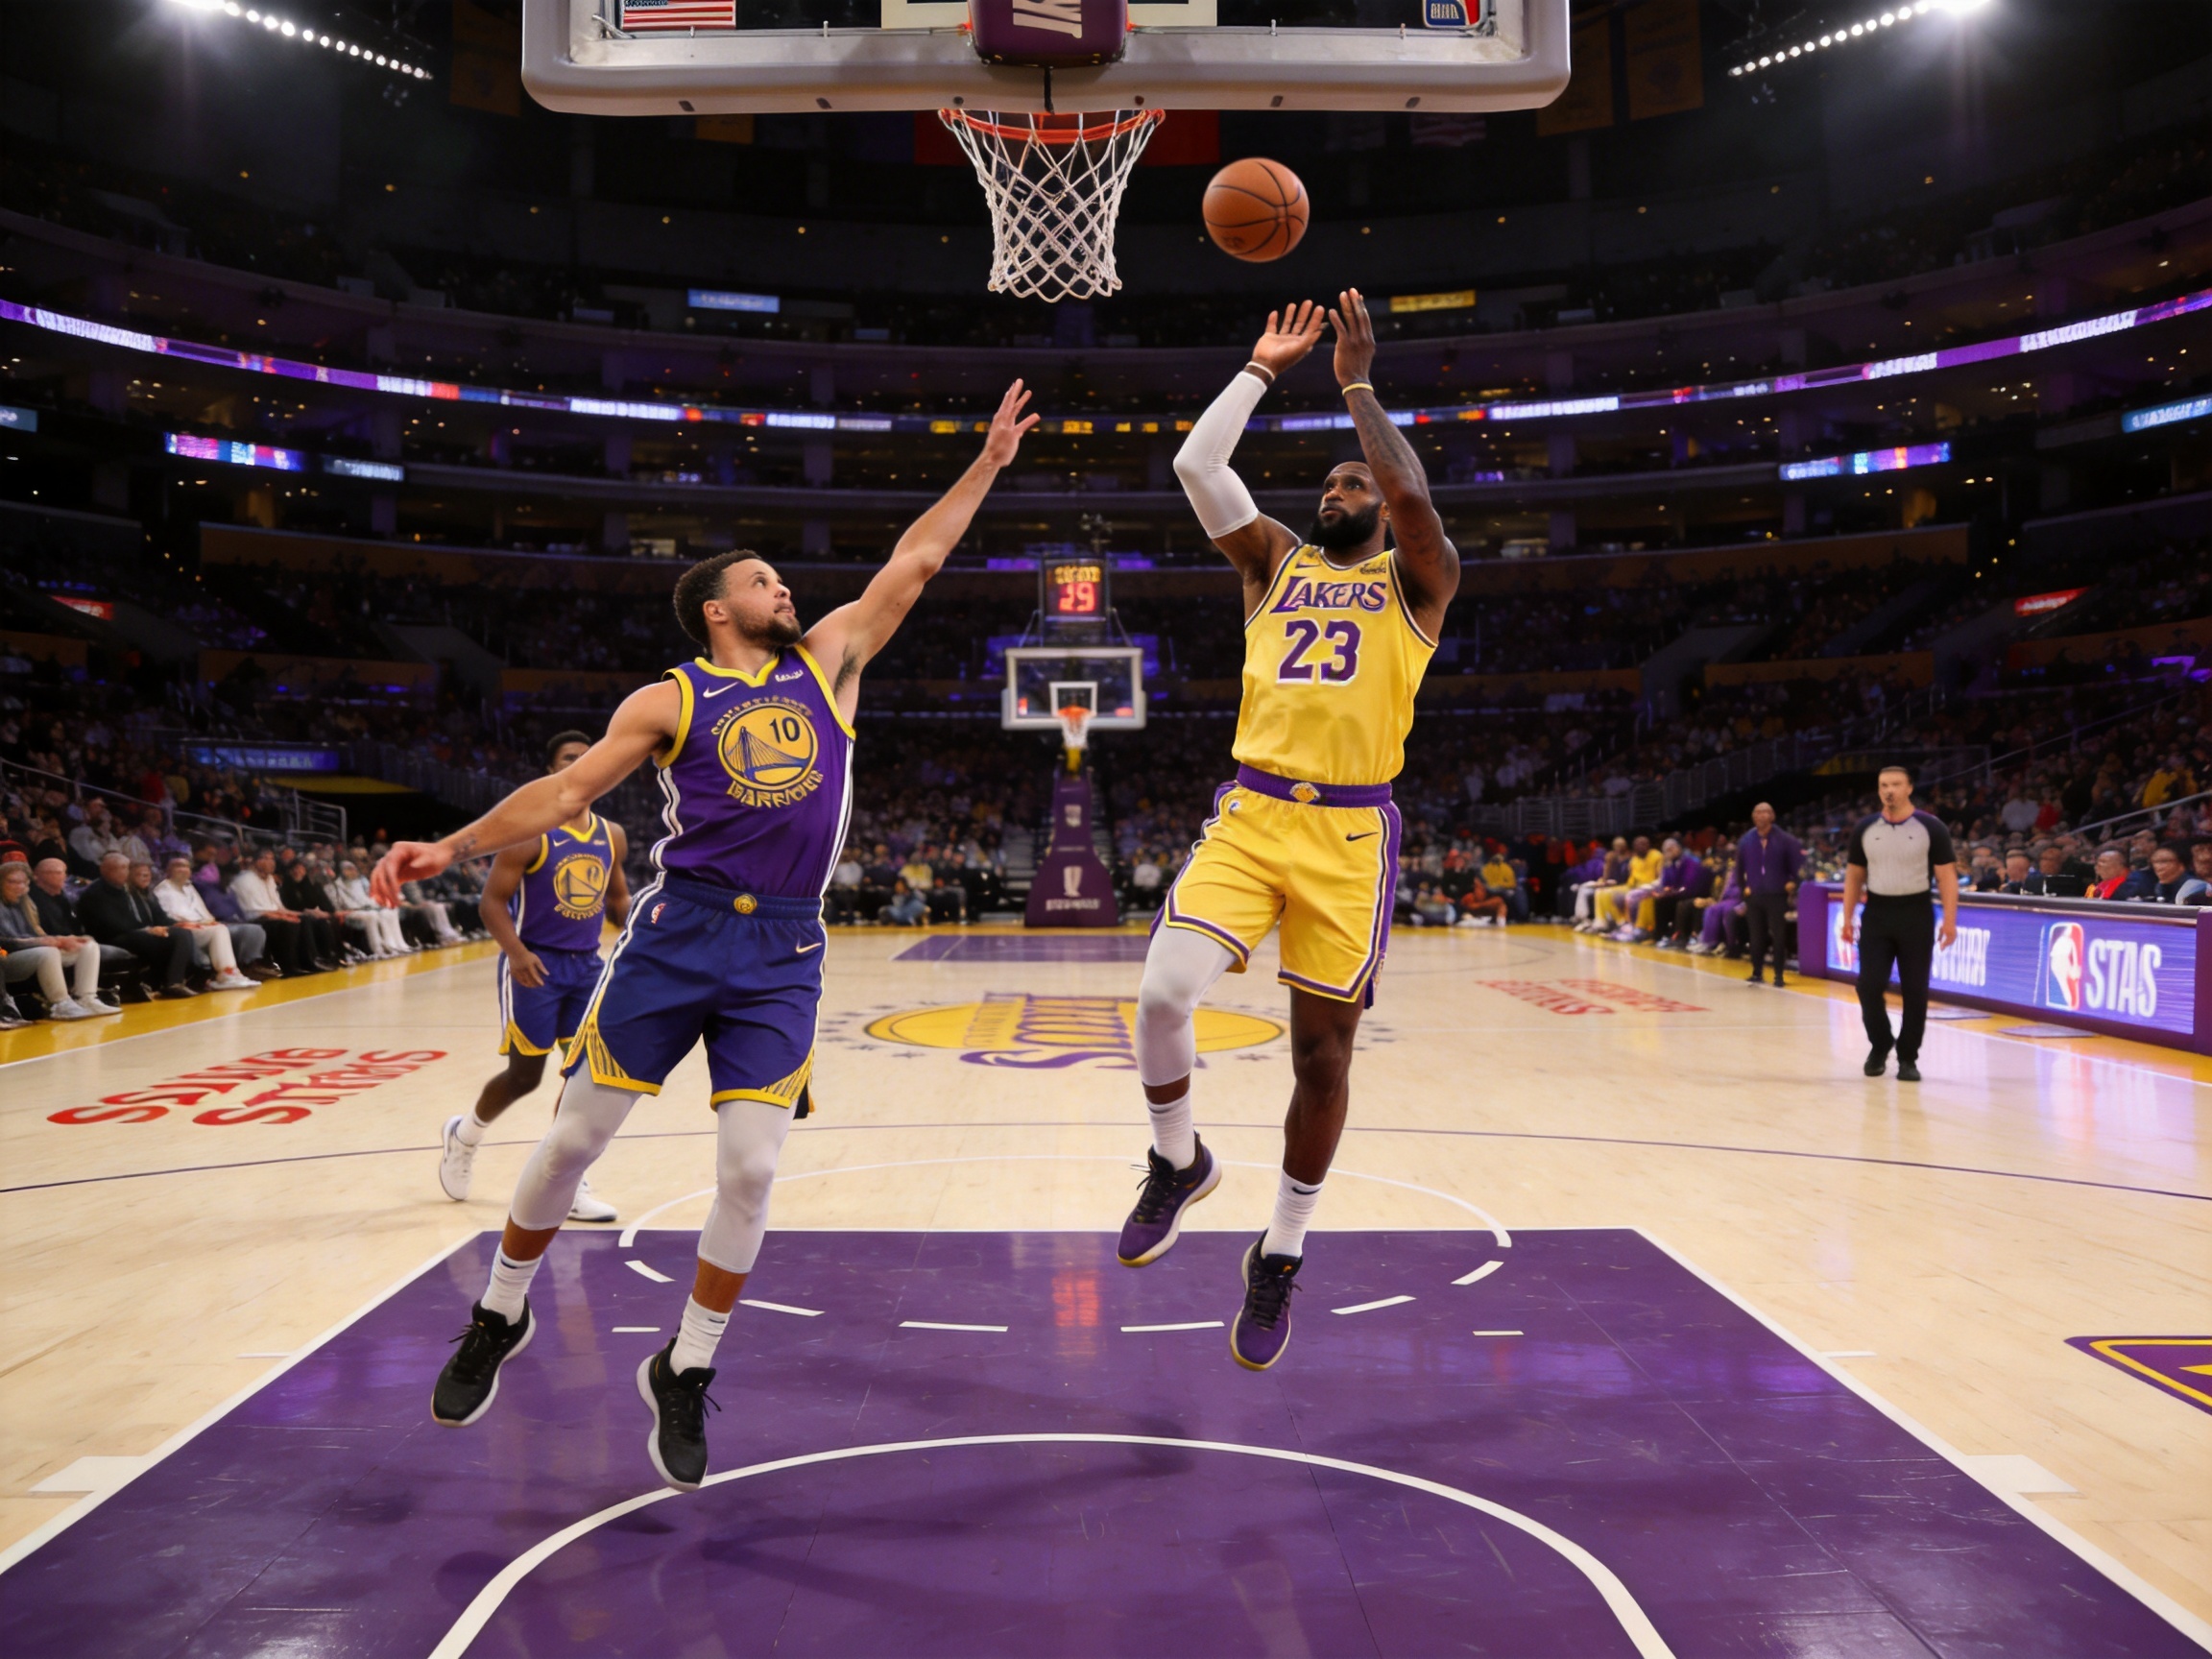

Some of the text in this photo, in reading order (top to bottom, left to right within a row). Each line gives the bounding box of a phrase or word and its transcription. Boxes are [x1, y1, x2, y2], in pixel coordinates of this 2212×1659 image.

[1269, 576, 1386, 613] LAKERS
[1277, 618, 1361, 685] 23
[769, 716, 801, 744] 10
